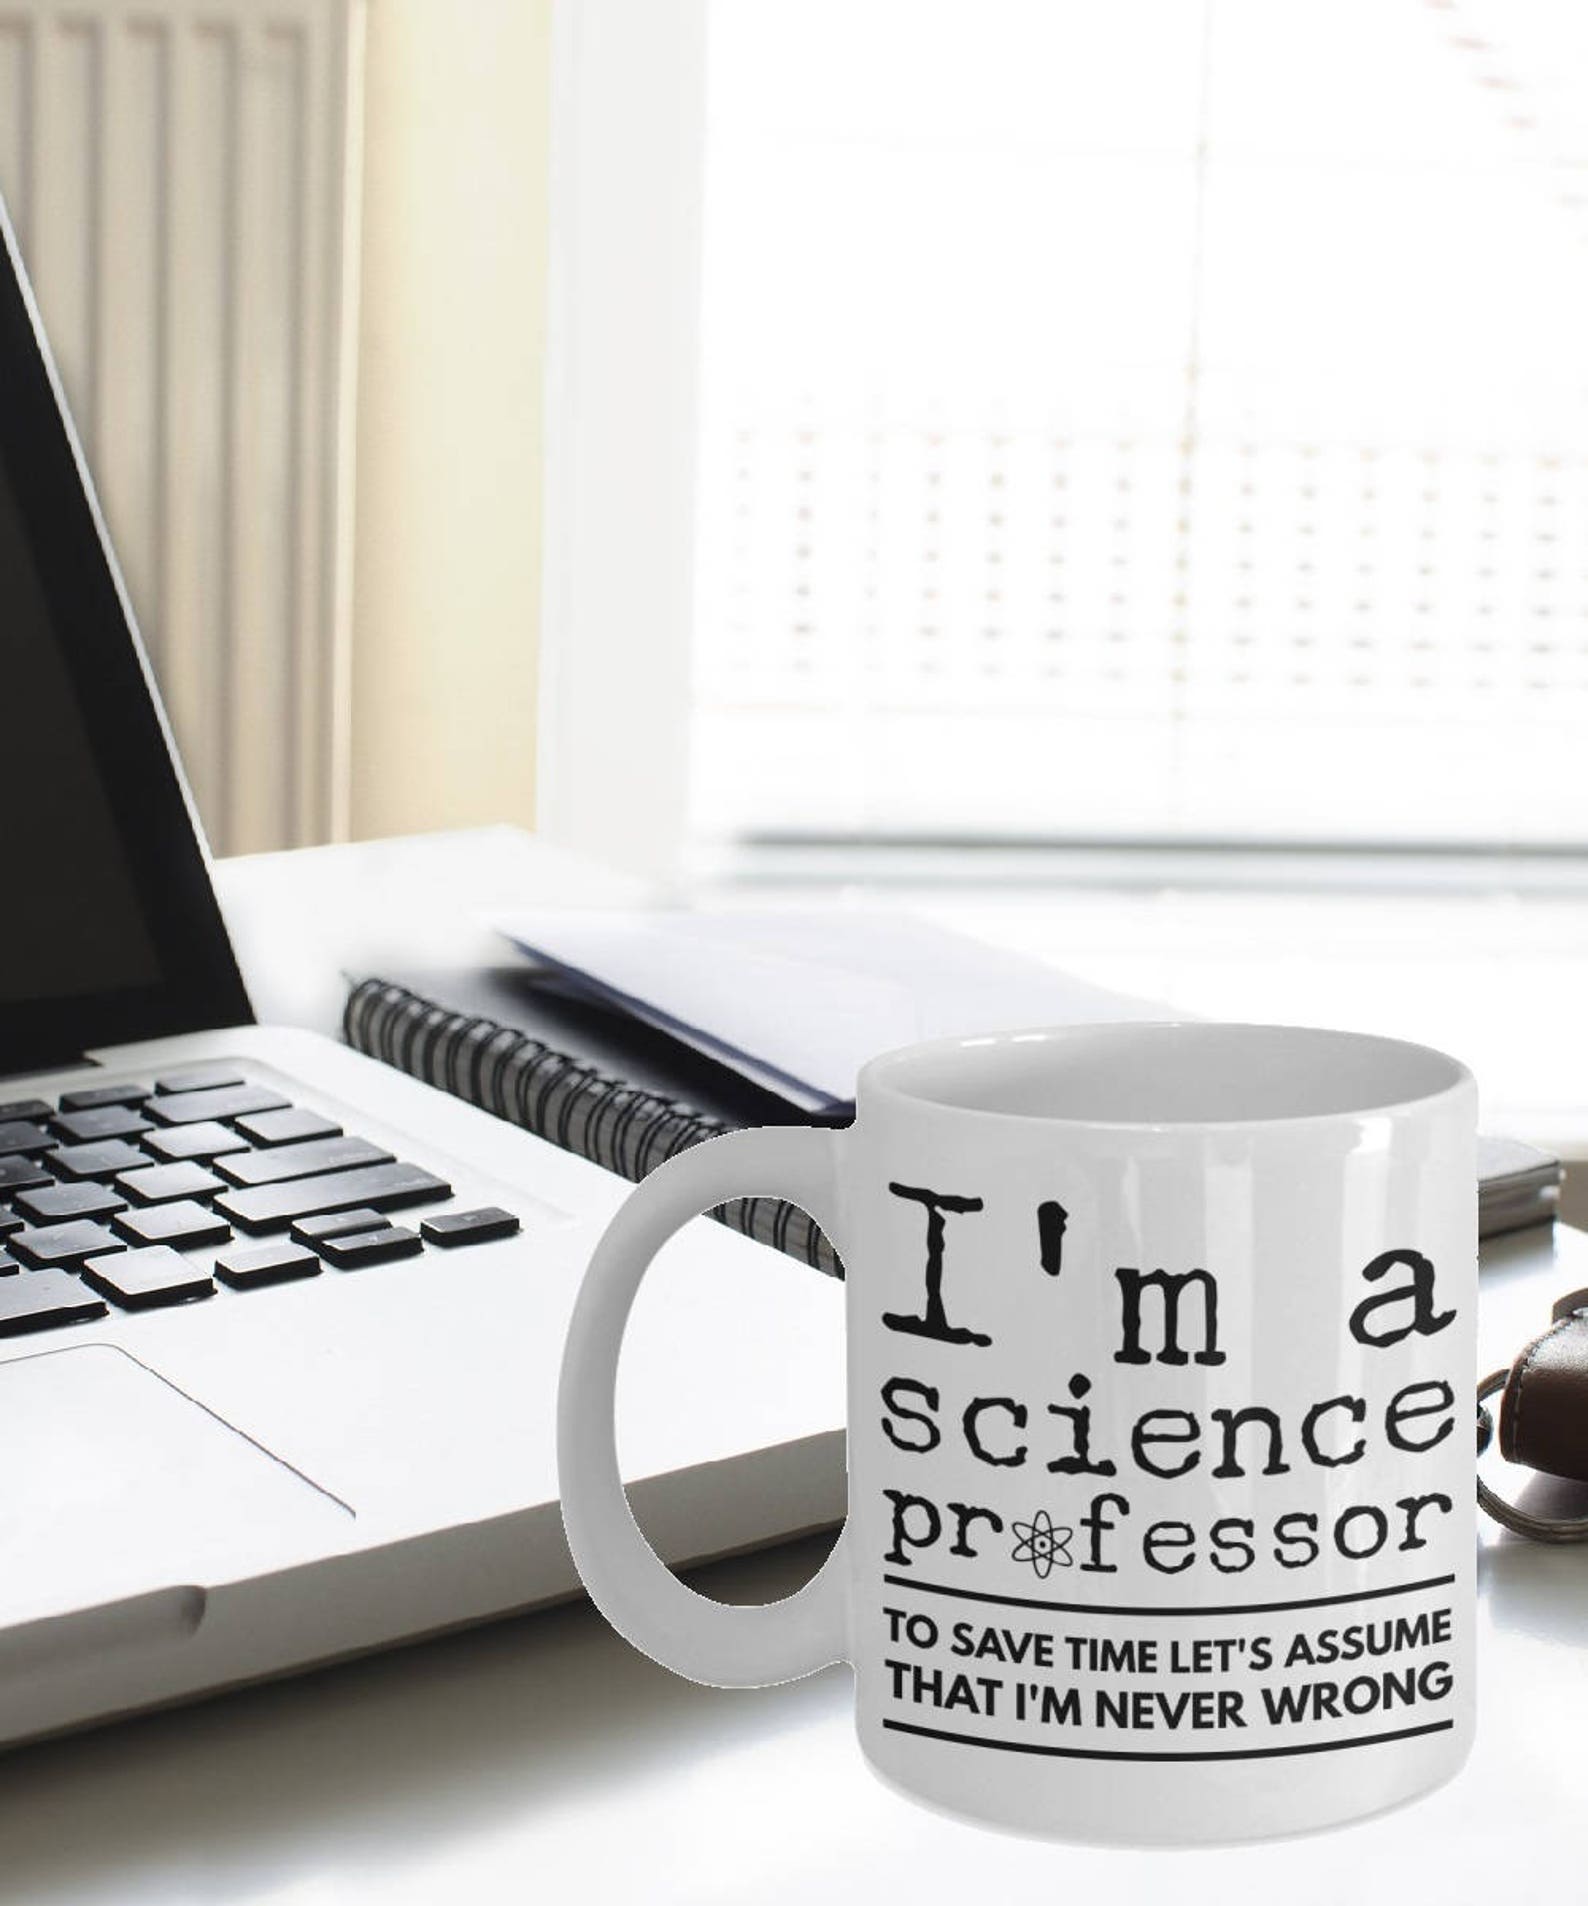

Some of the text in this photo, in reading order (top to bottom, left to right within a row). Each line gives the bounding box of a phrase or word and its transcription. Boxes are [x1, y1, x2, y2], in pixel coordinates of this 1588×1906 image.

[881, 1181, 1457, 1367] I'm a
[880, 1373, 1455, 1480] science
[882, 1607, 1452, 1674] TO SAVE TIME LET'S ASSUME
[884, 1658, 1453, 1730] THAT I'M NEVER WRONG
